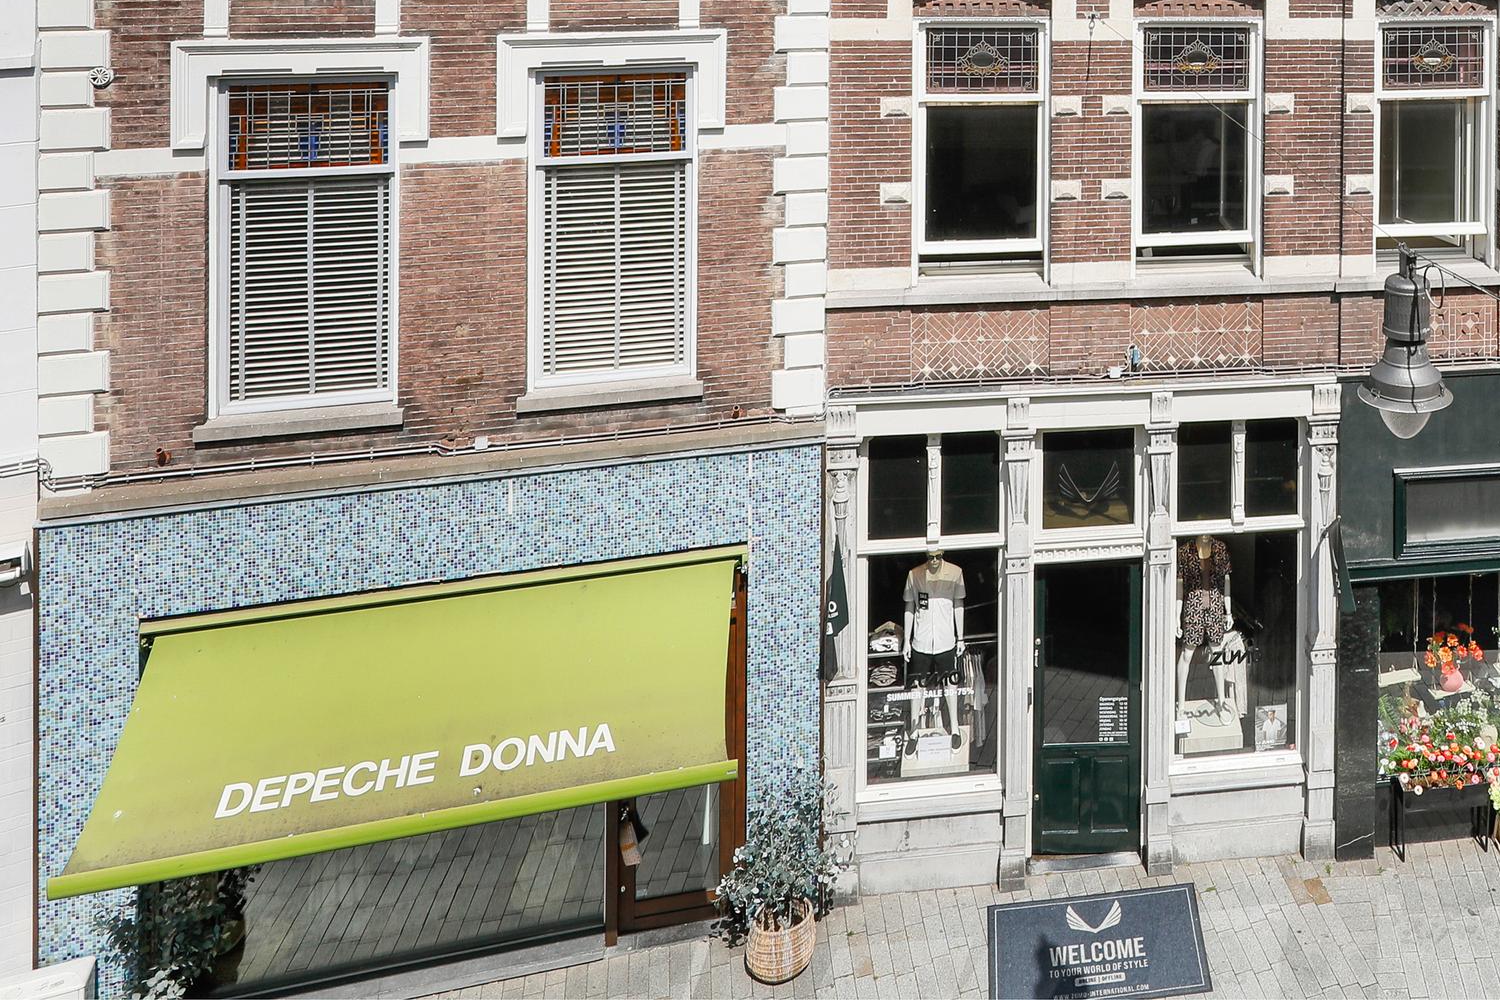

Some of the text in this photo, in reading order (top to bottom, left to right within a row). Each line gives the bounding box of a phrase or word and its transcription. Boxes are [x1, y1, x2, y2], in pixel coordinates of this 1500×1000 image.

[886, 690, 921, 702] SUMMER
[923, 689, 943, 699] SALE
[214, 723, 616, 818] DEPECHE DONNA
[1049, 937, 1146, 967] WELCOME
[1049, 959, 1149, 978] TO YOUR WORLD OF STYLE
